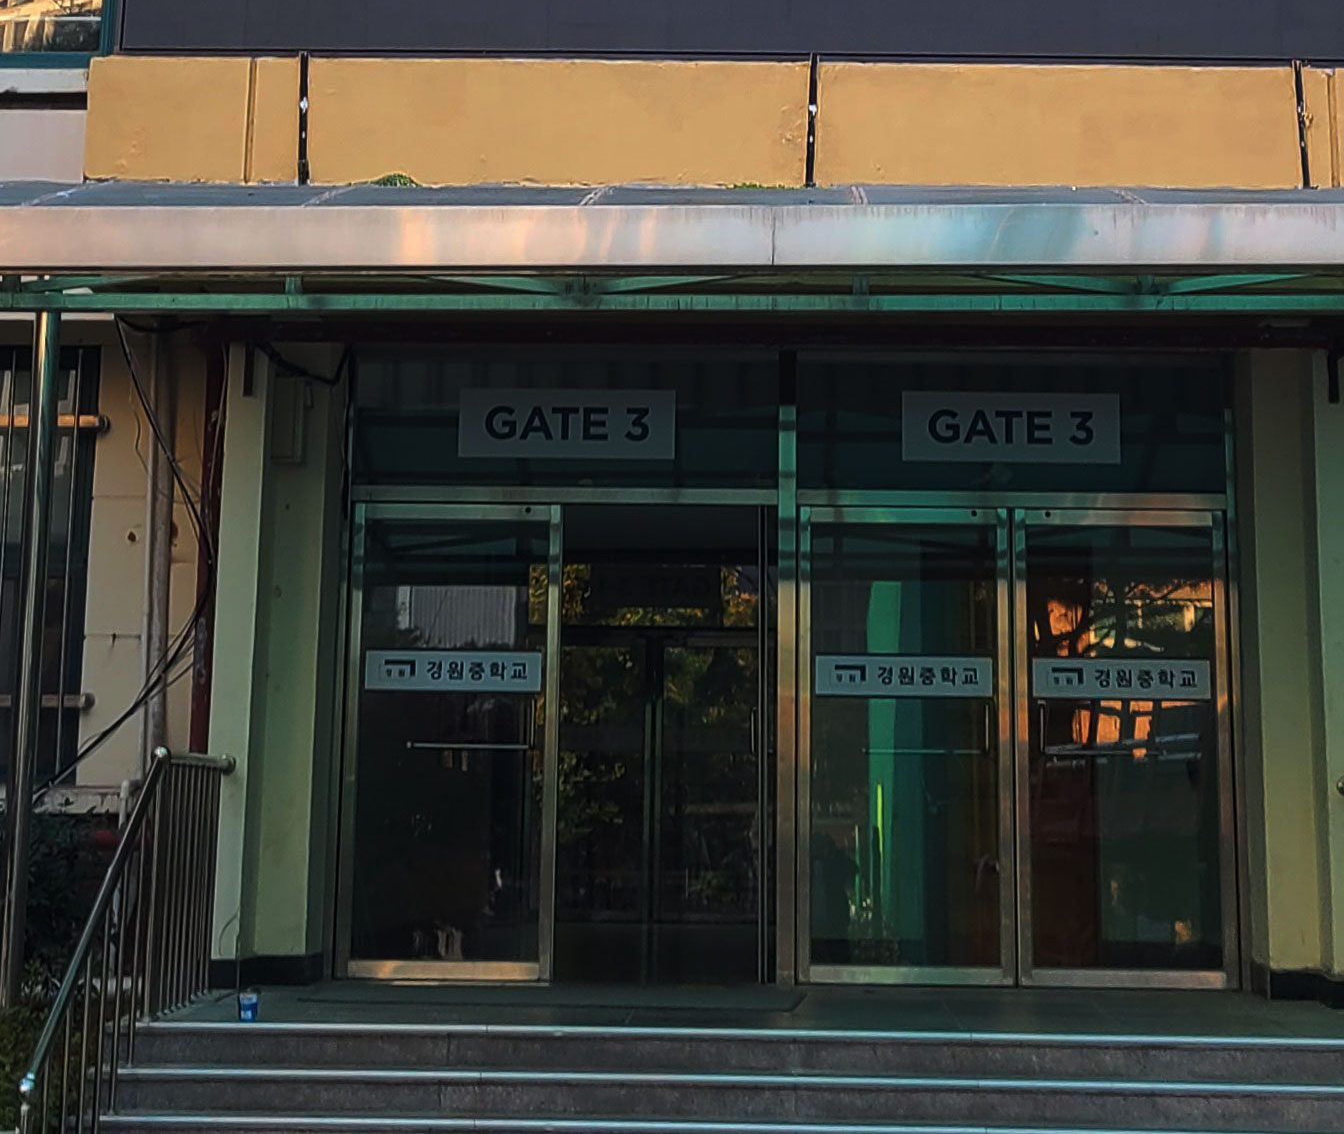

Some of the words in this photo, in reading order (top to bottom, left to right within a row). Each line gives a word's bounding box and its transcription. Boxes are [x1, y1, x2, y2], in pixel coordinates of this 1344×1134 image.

[484, 406, 610, 442] GATE
[624, 407, 651, 443] 3
[928, 409, 1054, 446] GATE
[1069, 411, 1096, 447] 3
[426, 661, 529, 682] 경원중학교
[877, 666, 980, 688] 경원중학교
[1094, 668, 1199, 690] 경원중학교
